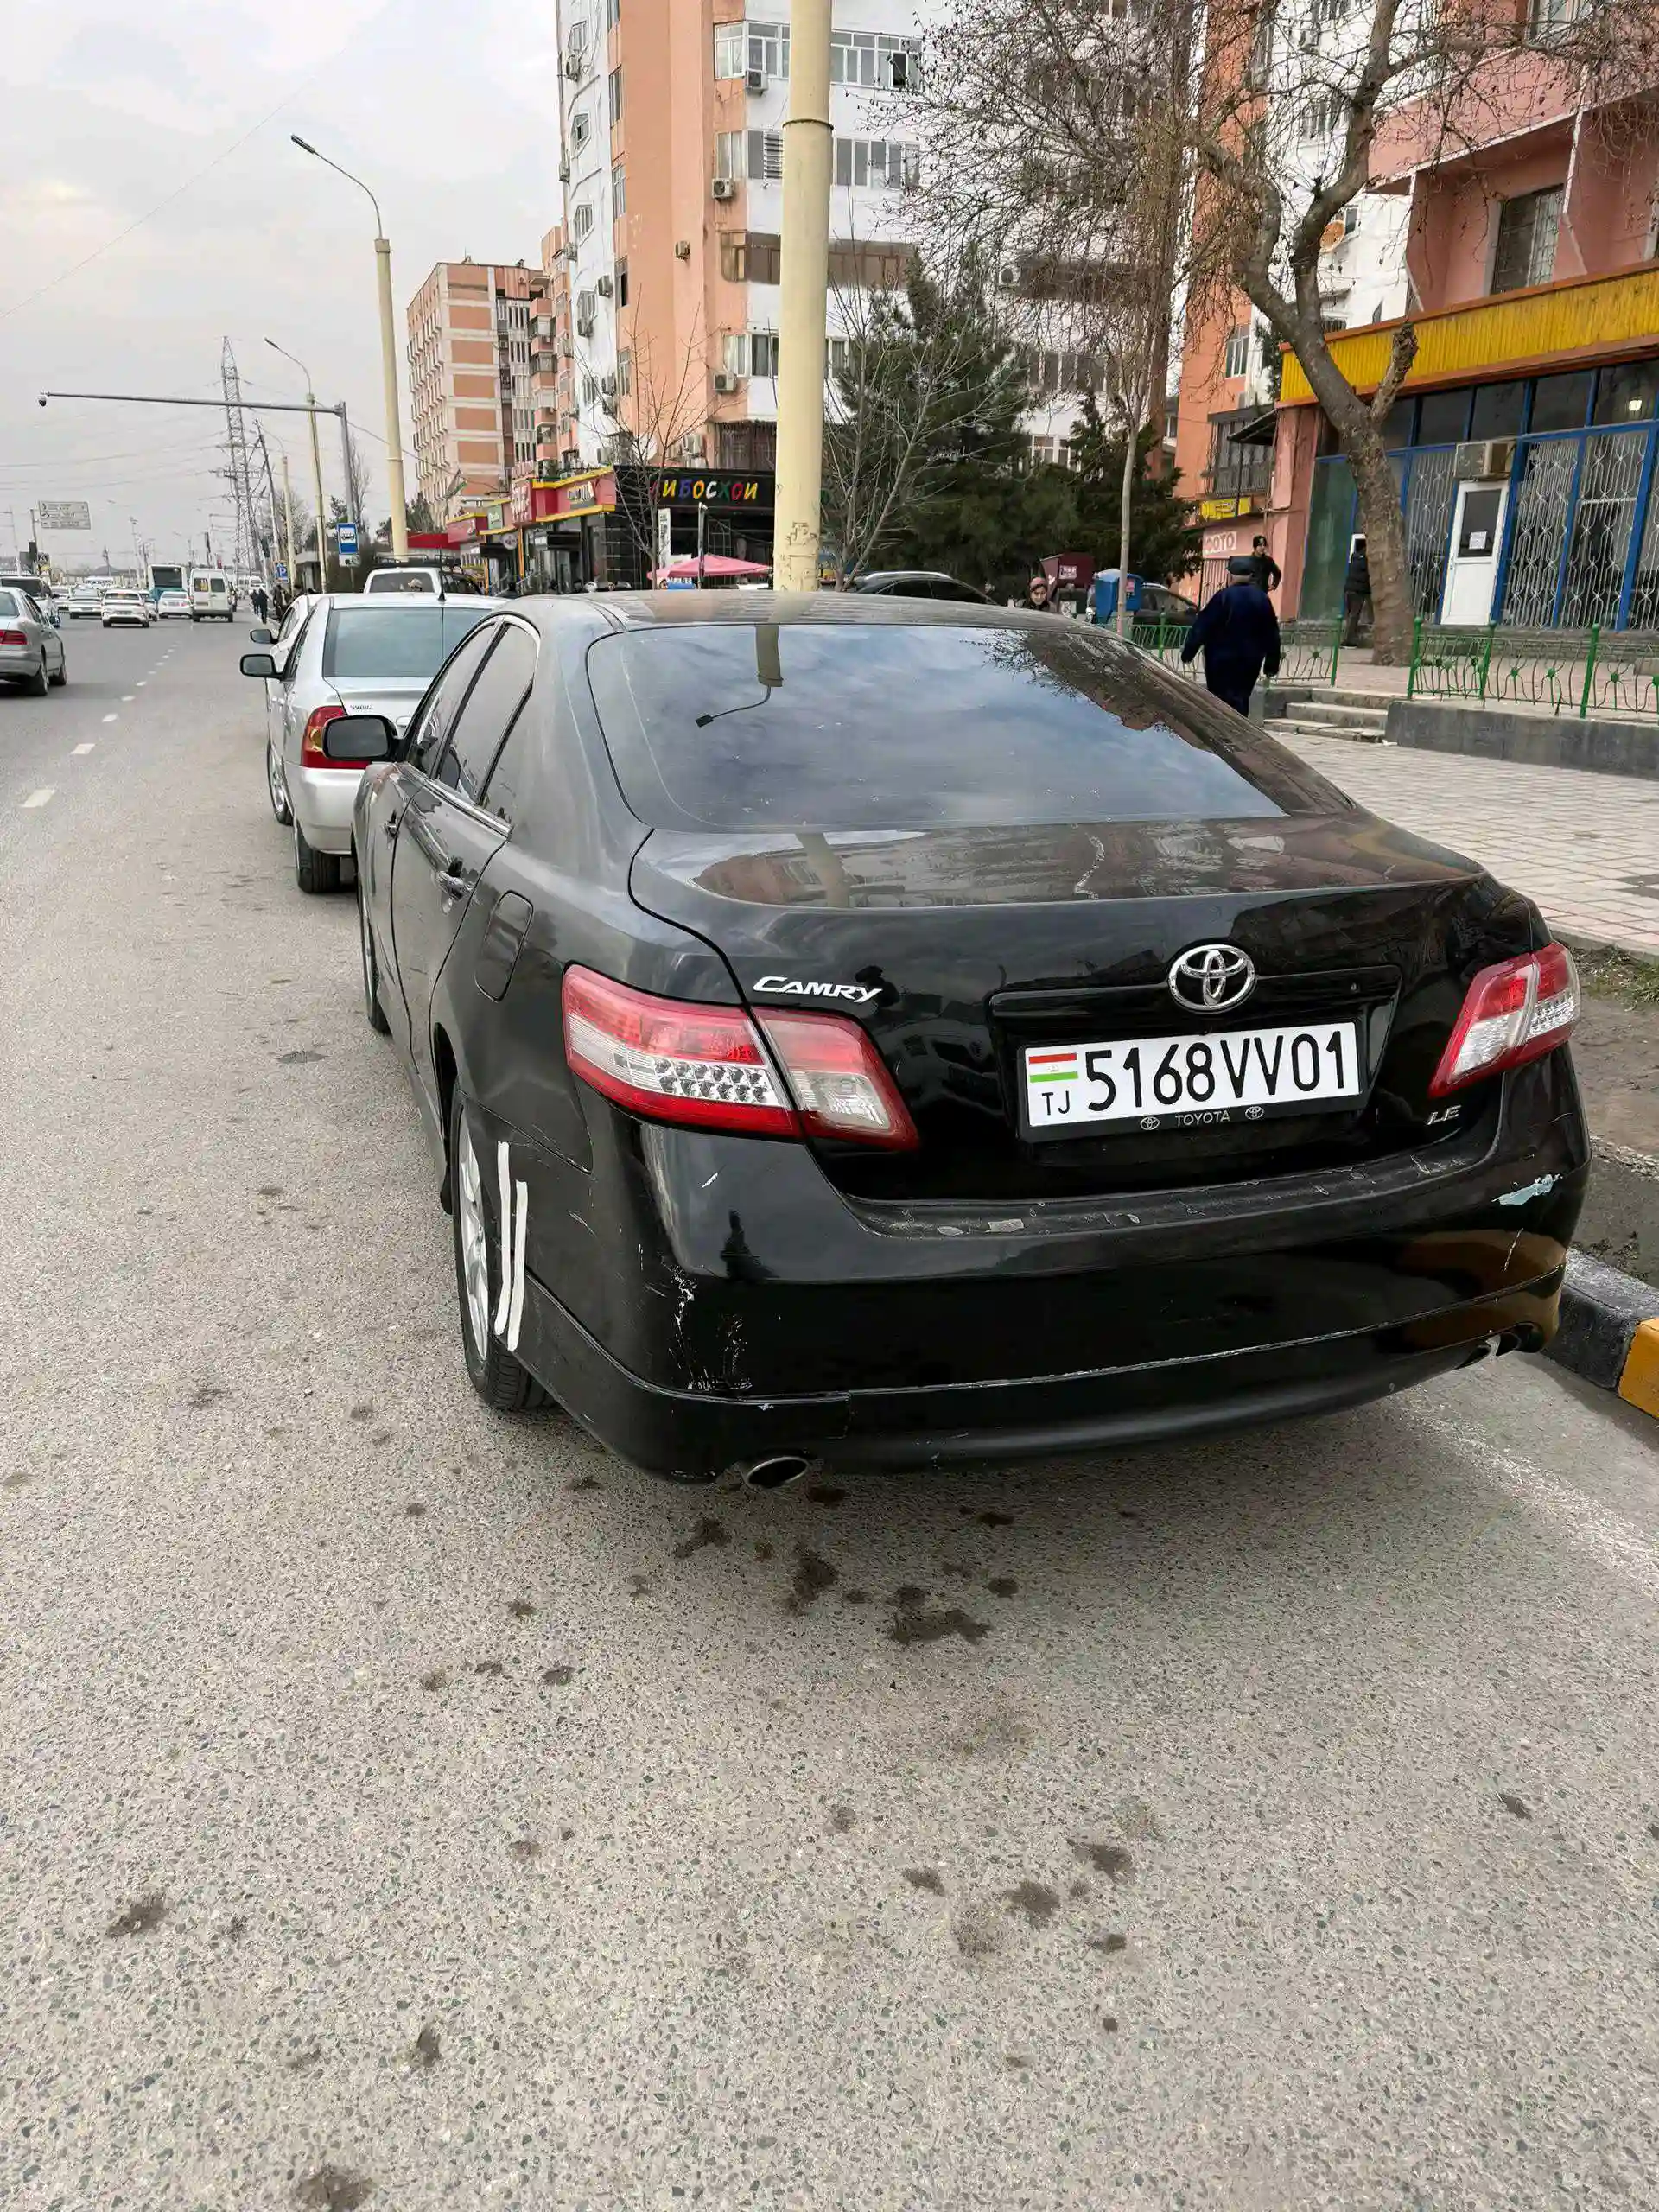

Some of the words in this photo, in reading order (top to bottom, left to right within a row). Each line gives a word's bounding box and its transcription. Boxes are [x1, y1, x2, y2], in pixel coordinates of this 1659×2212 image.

[753, 976, 883, 1003] CAMRY
[1041, 1090, 1071, 1116] TJ
[1426, 1104, 1461, 1125] LE
[1175, 1110, 1230, 1127] TOYOTA
